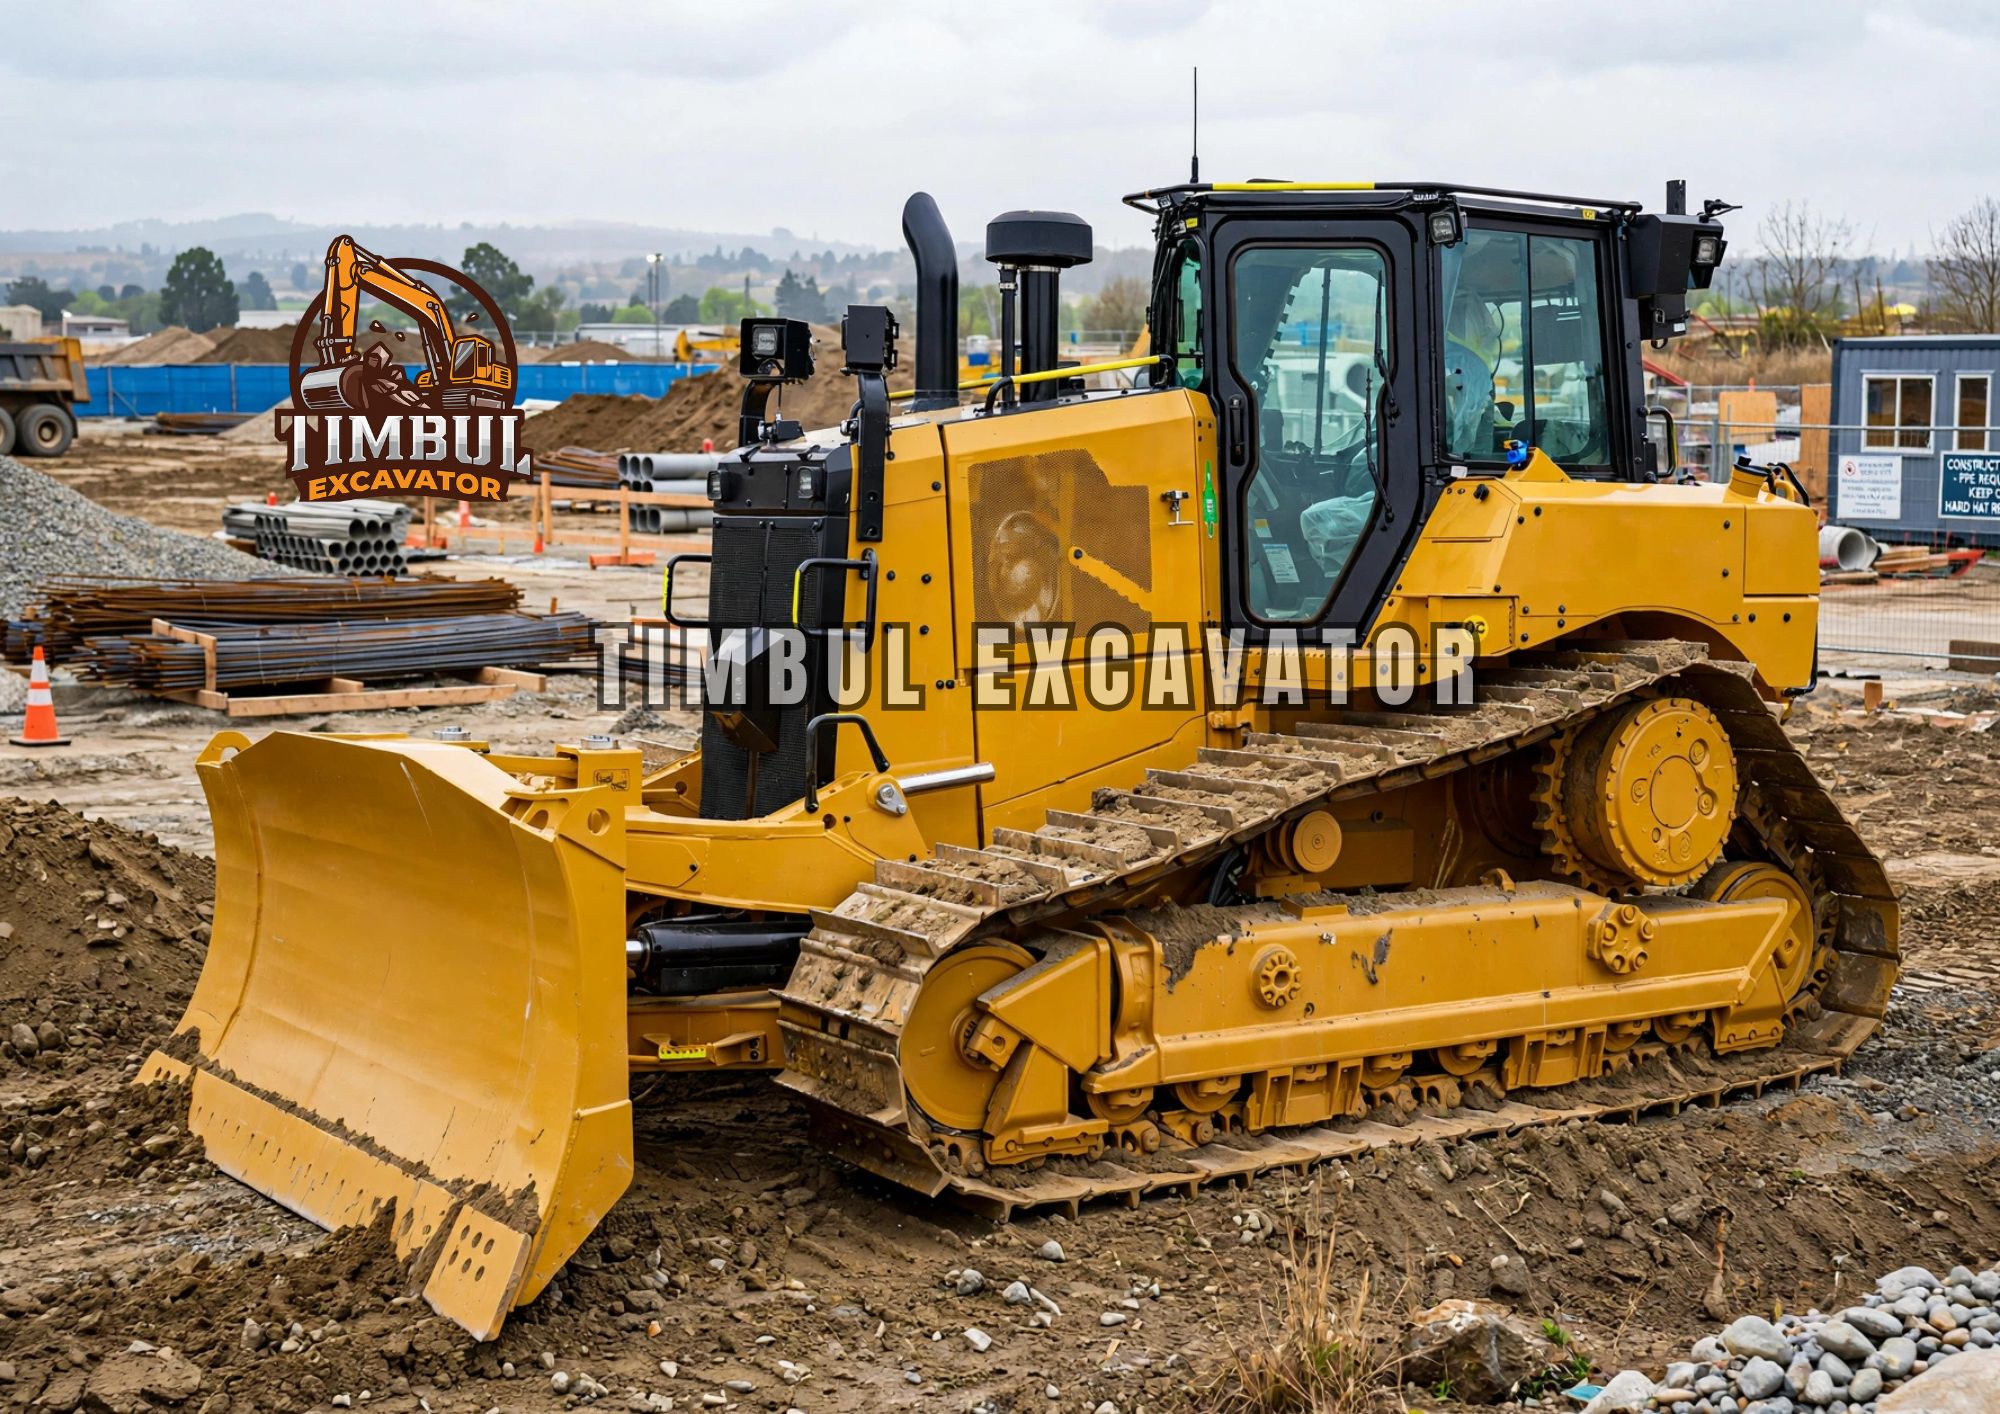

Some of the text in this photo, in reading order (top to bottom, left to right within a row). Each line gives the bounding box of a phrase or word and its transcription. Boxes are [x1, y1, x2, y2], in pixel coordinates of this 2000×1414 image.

[1969, 487, 1993, 499] KEEP
[1945, 500, 1970, 513] HARD
[1973, 501, 1990, 514] HAT
